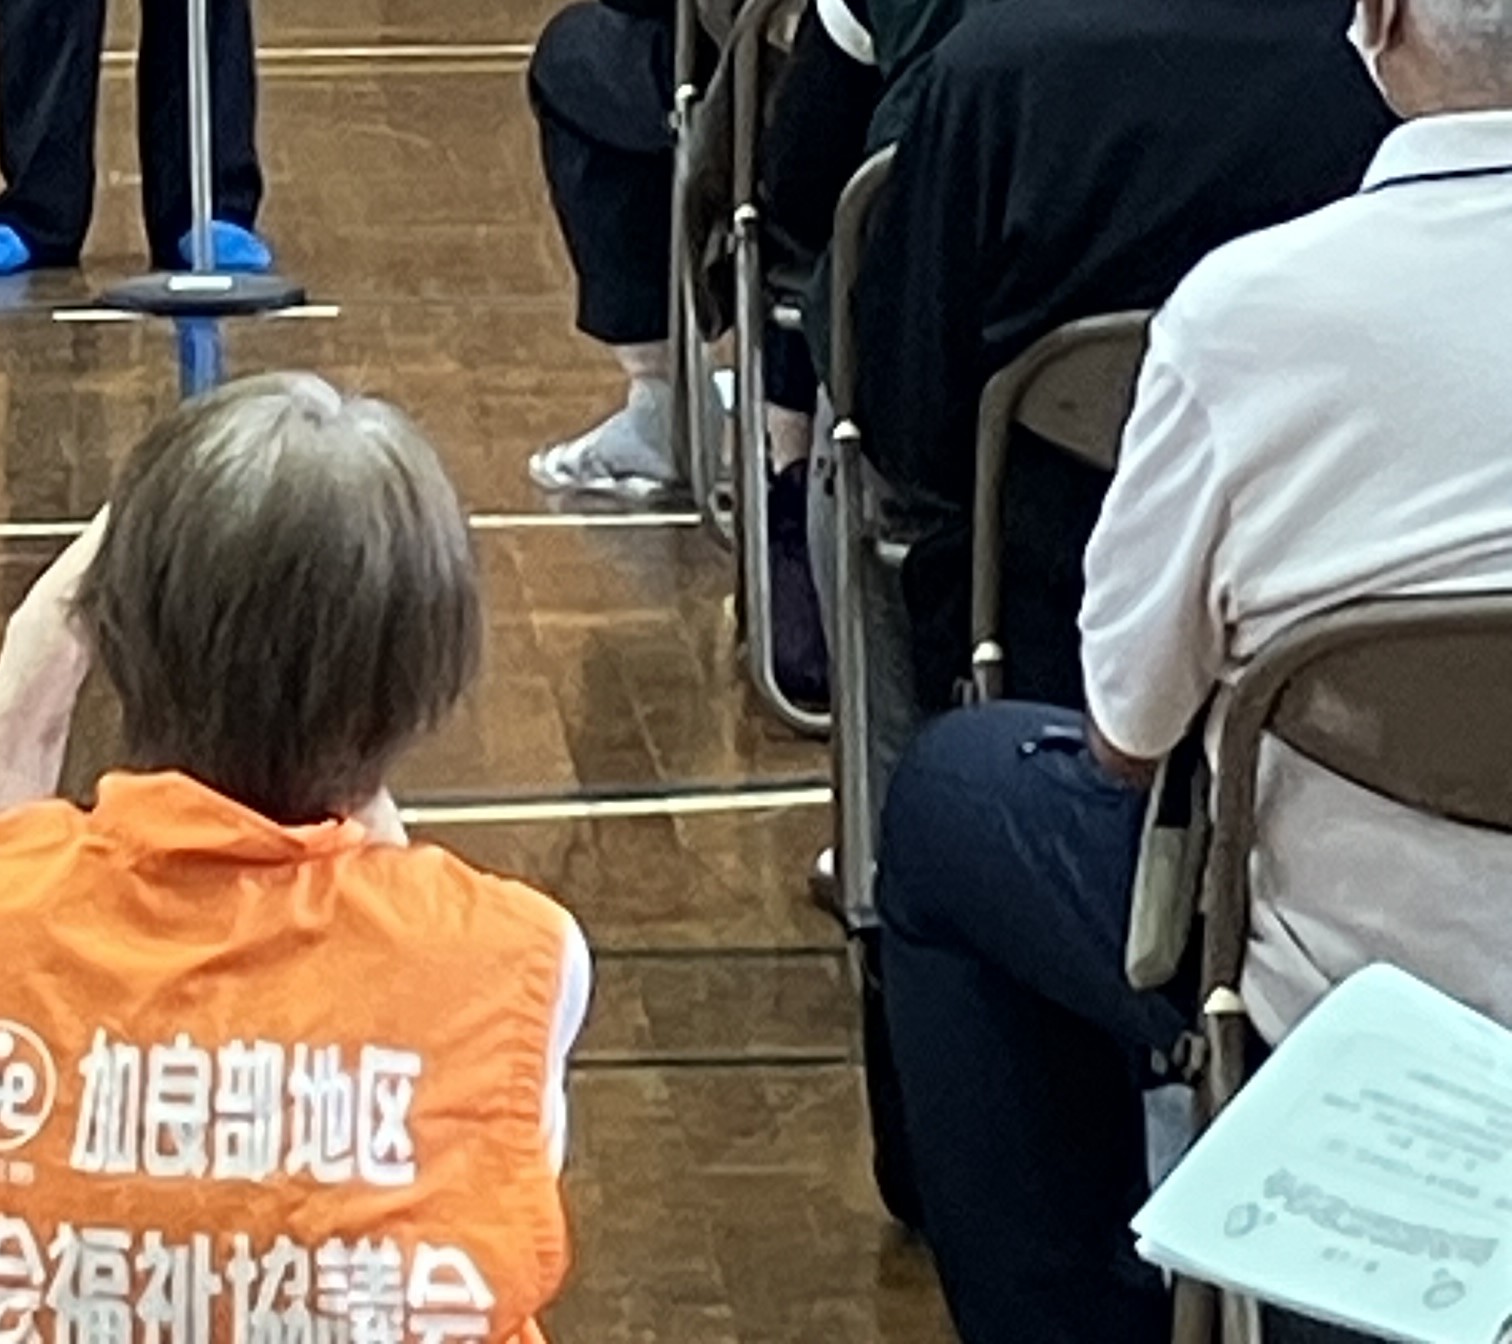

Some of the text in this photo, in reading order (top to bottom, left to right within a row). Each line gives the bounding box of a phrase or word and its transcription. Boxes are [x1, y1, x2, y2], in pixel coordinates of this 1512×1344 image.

[69, 1028, 423, 1186] 加良部地区
